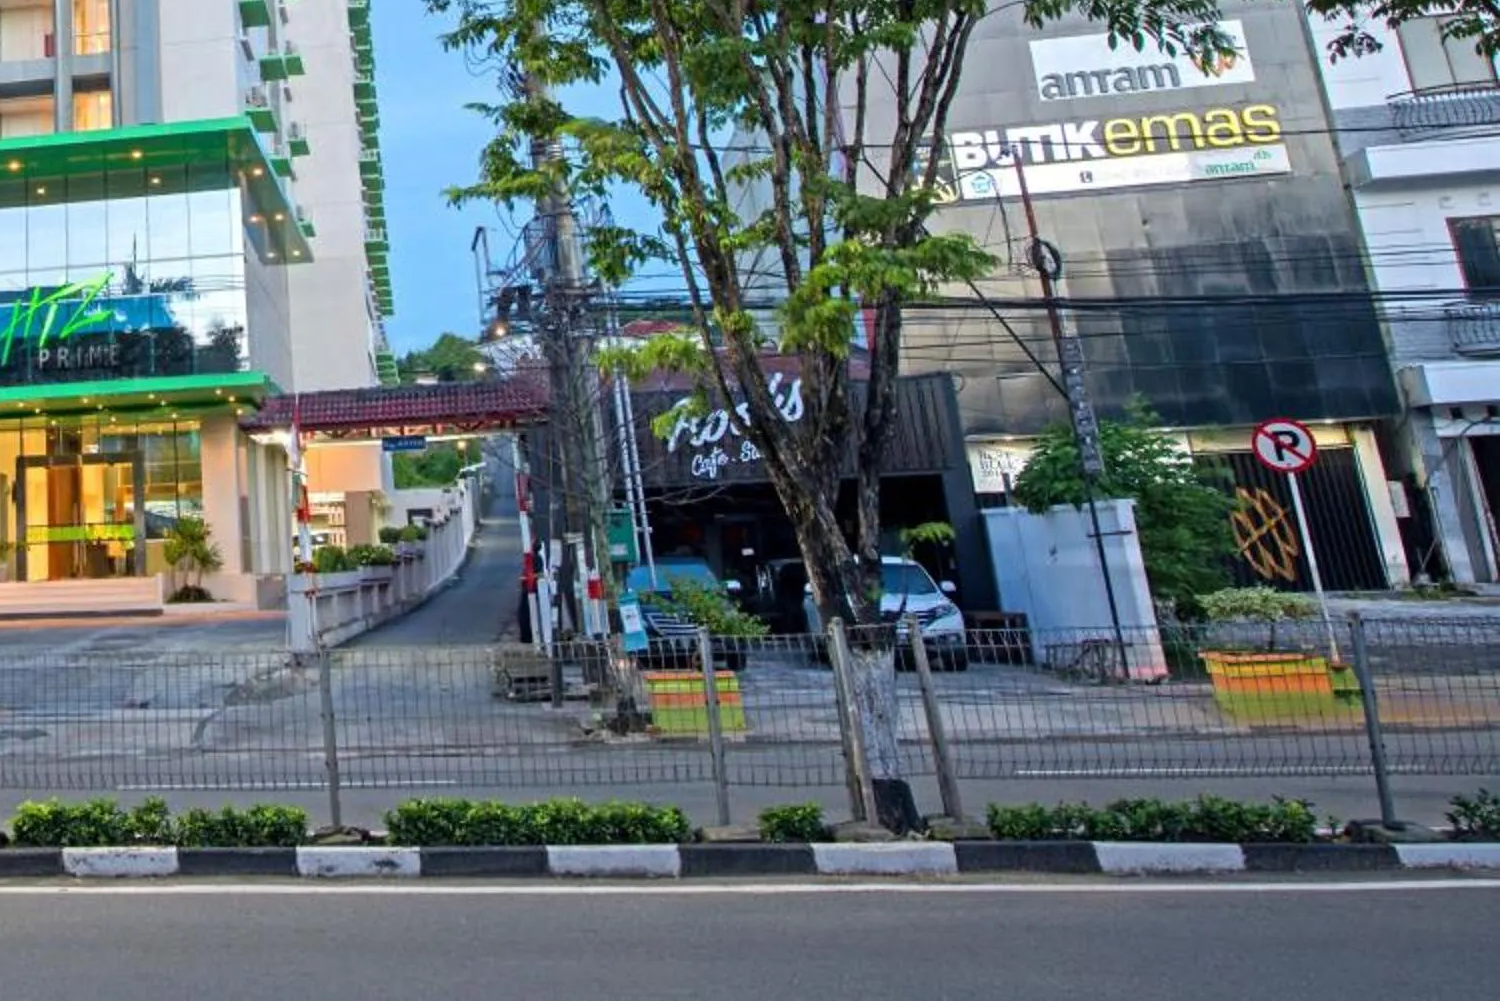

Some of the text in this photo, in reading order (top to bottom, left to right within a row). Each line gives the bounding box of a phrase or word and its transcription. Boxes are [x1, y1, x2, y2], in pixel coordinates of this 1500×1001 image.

[1041, 62, 1182, 99] antam
[952, 103, 1282, 170] BUTIK emas
[38, 344, 121, 369] PRIME
[1271, 430, 1301, 462] P
